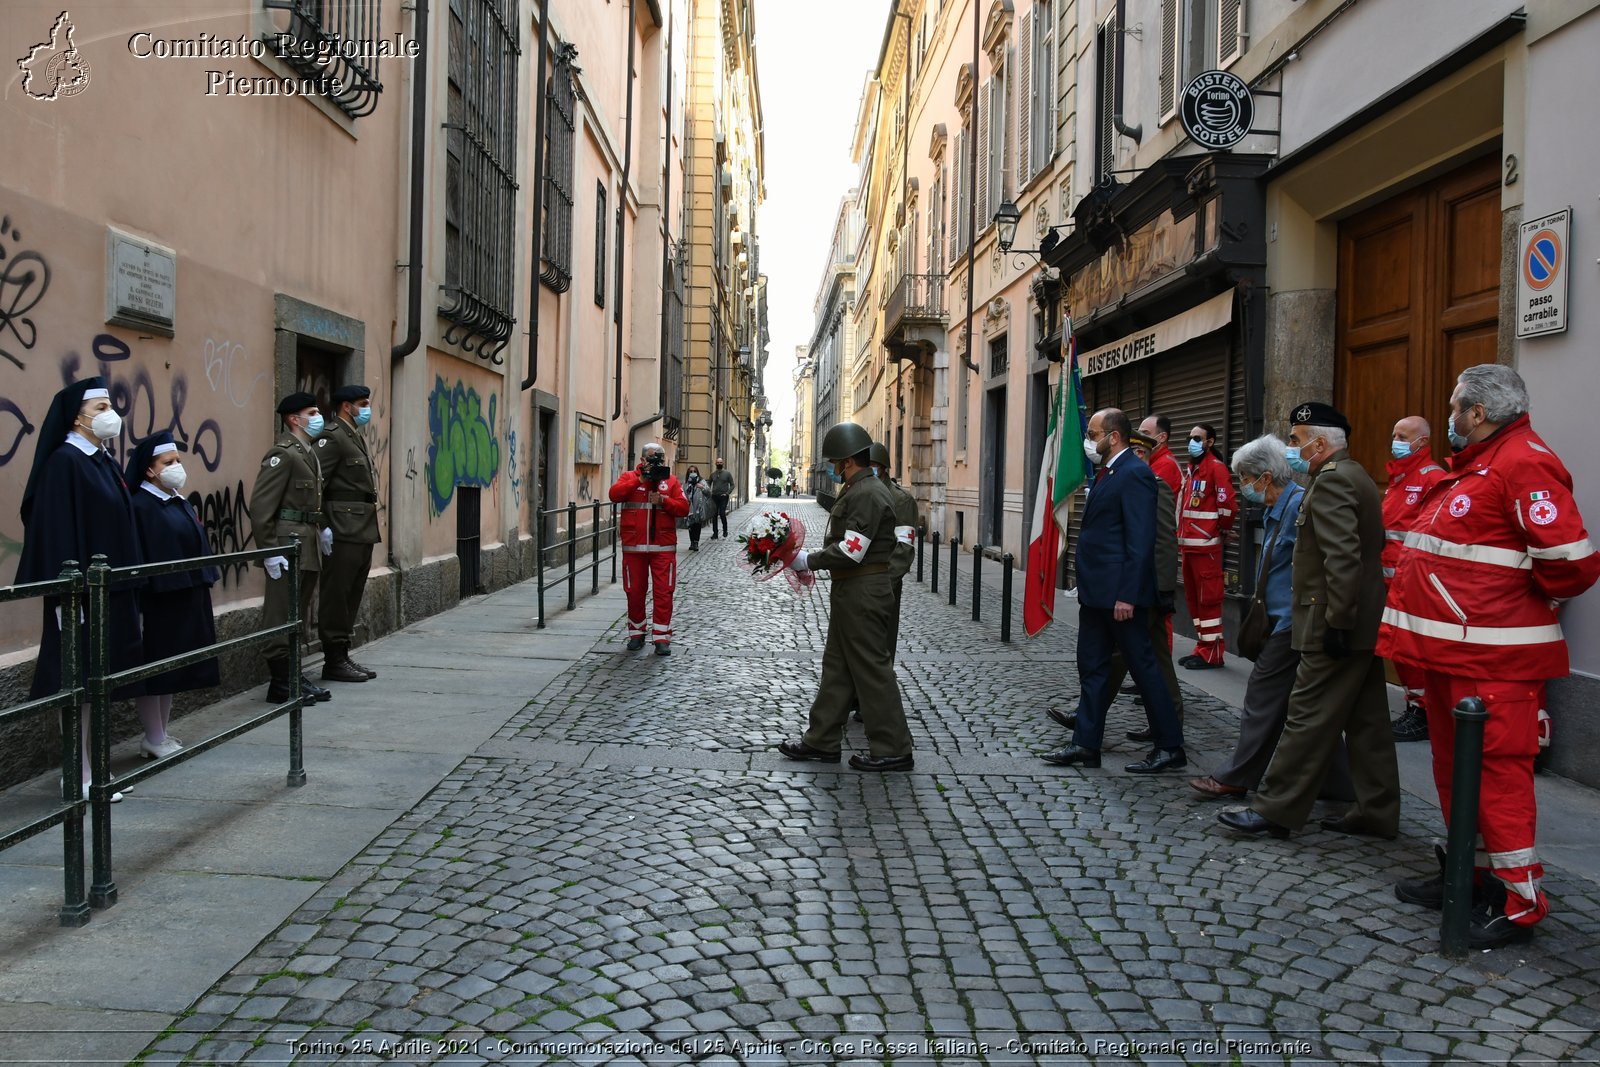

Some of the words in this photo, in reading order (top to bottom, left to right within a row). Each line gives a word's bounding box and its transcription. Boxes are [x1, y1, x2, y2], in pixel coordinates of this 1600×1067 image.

[1188, 75, 1247, 99] BUSTERS
[1206, 91, 1230, 100] Torino
[1192, 125, 1244, 144] COFFEE
[1505, 154, 1519, 186] 2
[1547, 214, 1565, 225] TORINO
[1529, 294, 1553, 309] passo
[1524, 306, 1558, 322] carrabile
[1088, 347, 1121, 374] BUSTERS
[1122, 333, 1156, 363] COFFEE
